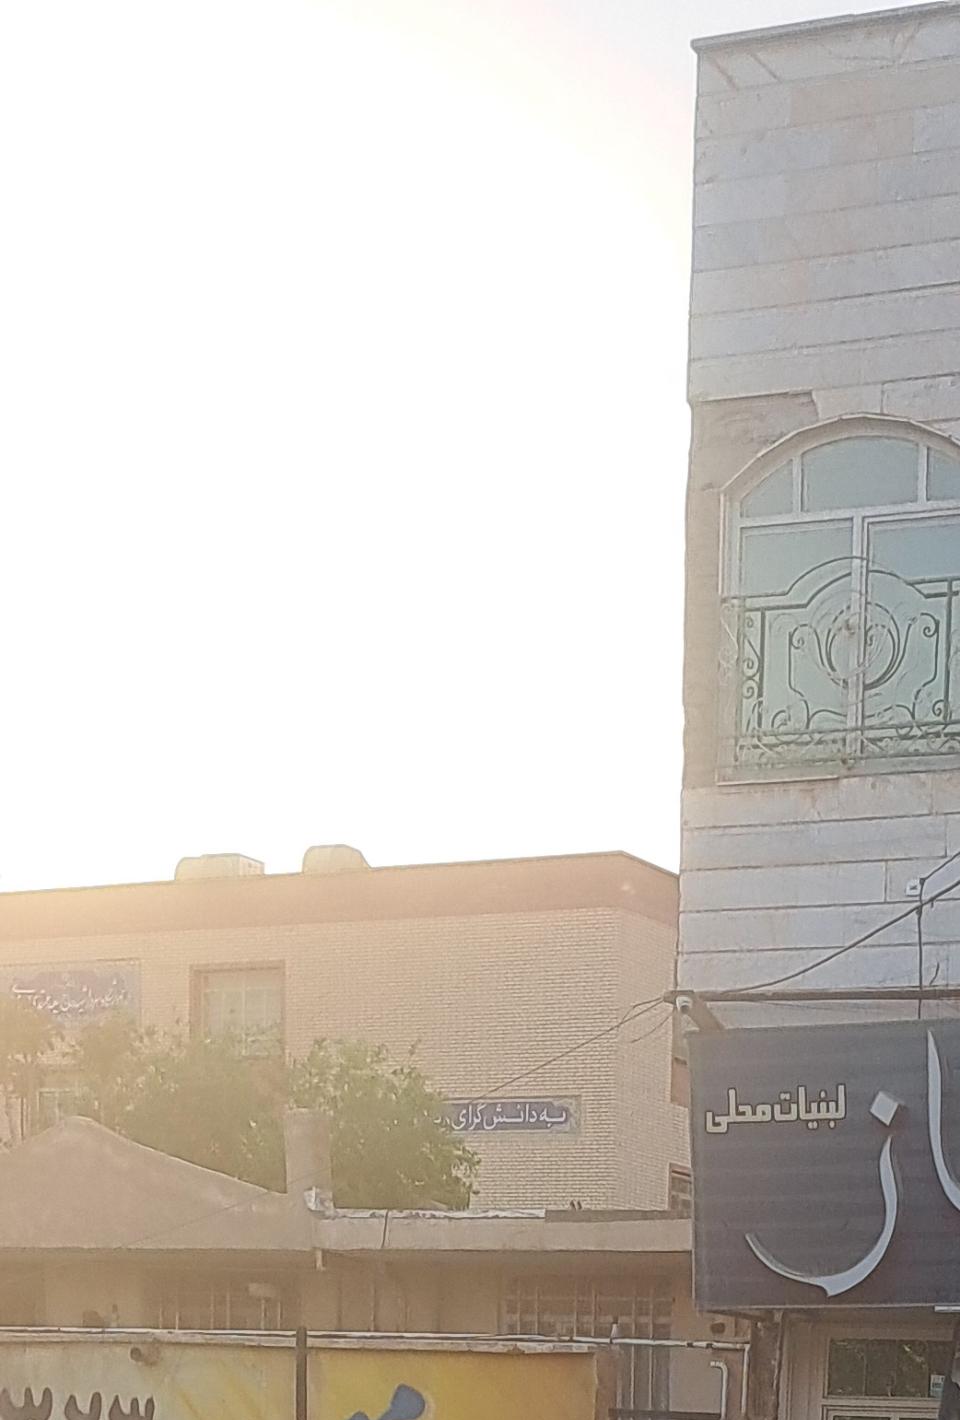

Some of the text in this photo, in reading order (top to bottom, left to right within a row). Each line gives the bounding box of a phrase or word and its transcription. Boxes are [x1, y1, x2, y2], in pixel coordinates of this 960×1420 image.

[452, 1104, 487, 1130] گرای
[483, 1104, 537, 1129] دانش
[539, 1106, 566, 1127] به
[706, 1083, 847, 1133] لبنیات محلی
